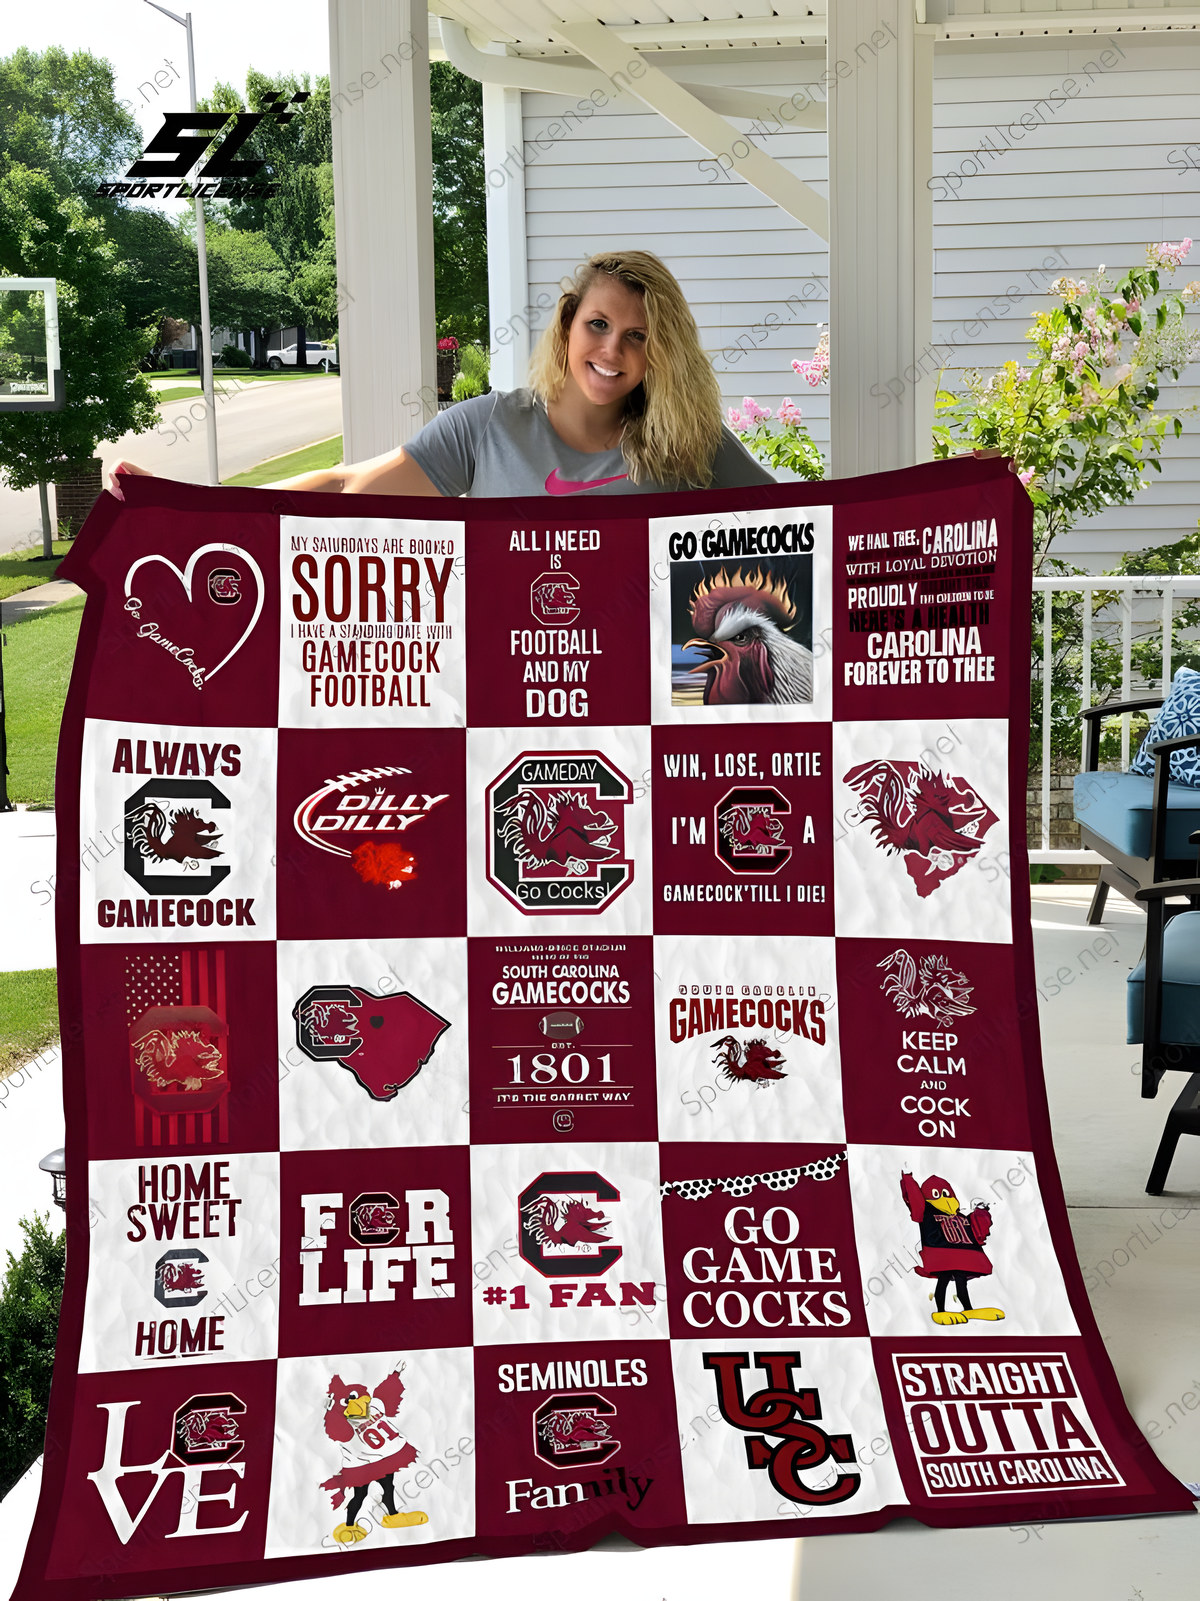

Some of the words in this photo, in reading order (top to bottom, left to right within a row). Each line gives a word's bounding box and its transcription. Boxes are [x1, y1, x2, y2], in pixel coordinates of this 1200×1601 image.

[509, 530, 541, 551] ALL
[546, 531, 551, 551] I
[554, 529, 601, 551] NEED
[668, 531, 697, 560] GO
[701, 523, 815, 557] GAMECOCKS
[848, 535, 864, 551] WE
[867, 533, 890, 550] HAIL
[923, 518, 998, 554] CAROLINA
[550, 554, 562, 569] IS
[846, 561, 880, 576] WITH
[885, 557, 926, 573] LOYAL
[931, 549, 998, 569] DEVOTION
[292, 553, 455, 623] SORRY
[848, 582, 919, 610] PROUDLY
[302, 640, 441, 674] GAMECOCK
[510, 629, 602, 656] FOOTBALL
[867, 626, 982, 659] CAROLINA
[523, 661, 559, 683] AND
[563, 660, 590, 682] MY
[844, 659, 921, 687] FOREVER
[926, 658, 949, 684] TO
[953, 656, 995, 683] THEE
[310, 675, 431, 708] FOOTBALL
[525, 688, 589, 718] DOG
[112, 738, 242, 777] ALWAYS
[521, 761, 598, 783] GAMEDAY
[663, 753, 707, 781] WIN,
[714, 752, 765, 781] LOSE,
[336, 793, 450, 812] DILLY
[308, 813, 428, 832] DILLY
[671, 816, 706, 845] I'M
[802, 815, 816, 844] A
[515, 883, 541, 901] Go
[547, 881, 610, 901] Cocks!
[786, 885, 791, 903] I
[797, 885, 826, 903] DIE!
[97, 898, 257, 928] GAMECOCK
[502, 964, 548, 979] SOUTH
[551, 964, 620, 979] CAROLINA
[491, 980, 631, 1006] GAMECOCKS
[669, 997, 827, 1047] GAMECOCKS
[902, 1030, 959, 1051] KEEP
[507, 1052, 616, 1084] 1801
[896, 1054, 967, 1076] CALM
[602, 1092, 631, 1101] WAY
[920, 1080, 947, 1091] AND
[900, 1095, 972, 1117] COCK
[918, 1119, 956, 1139] ON
[138, 1161, 231, 1204] HOME
[127, 1198, 242, 1243] SWEET
[724, 1206, 800, 1245] GO
[299, 1244, 456, 1307] LIFE
[682, 1246, 842, 1284] GAME
[482, 1285, 530, 1310] #1
[549, 1281, 657, 1309] FAN
[682, 1290, 852, 1329] COCKS
[135, 1315, 226, 1357] HOME
[498, 1358, 648, 1392] SEMINOLES
[901, 1362, 1067, 1397] STRAIGHT
[362, 1420, 400, 1450] 01
[702, 1351, 861, 1506] USC
[909, 1400, 1097, 1456] OUTTA
[926, 1461, 999, 1489] SOUTH
[998, 1455, 1113, 1485] CAROLINA
